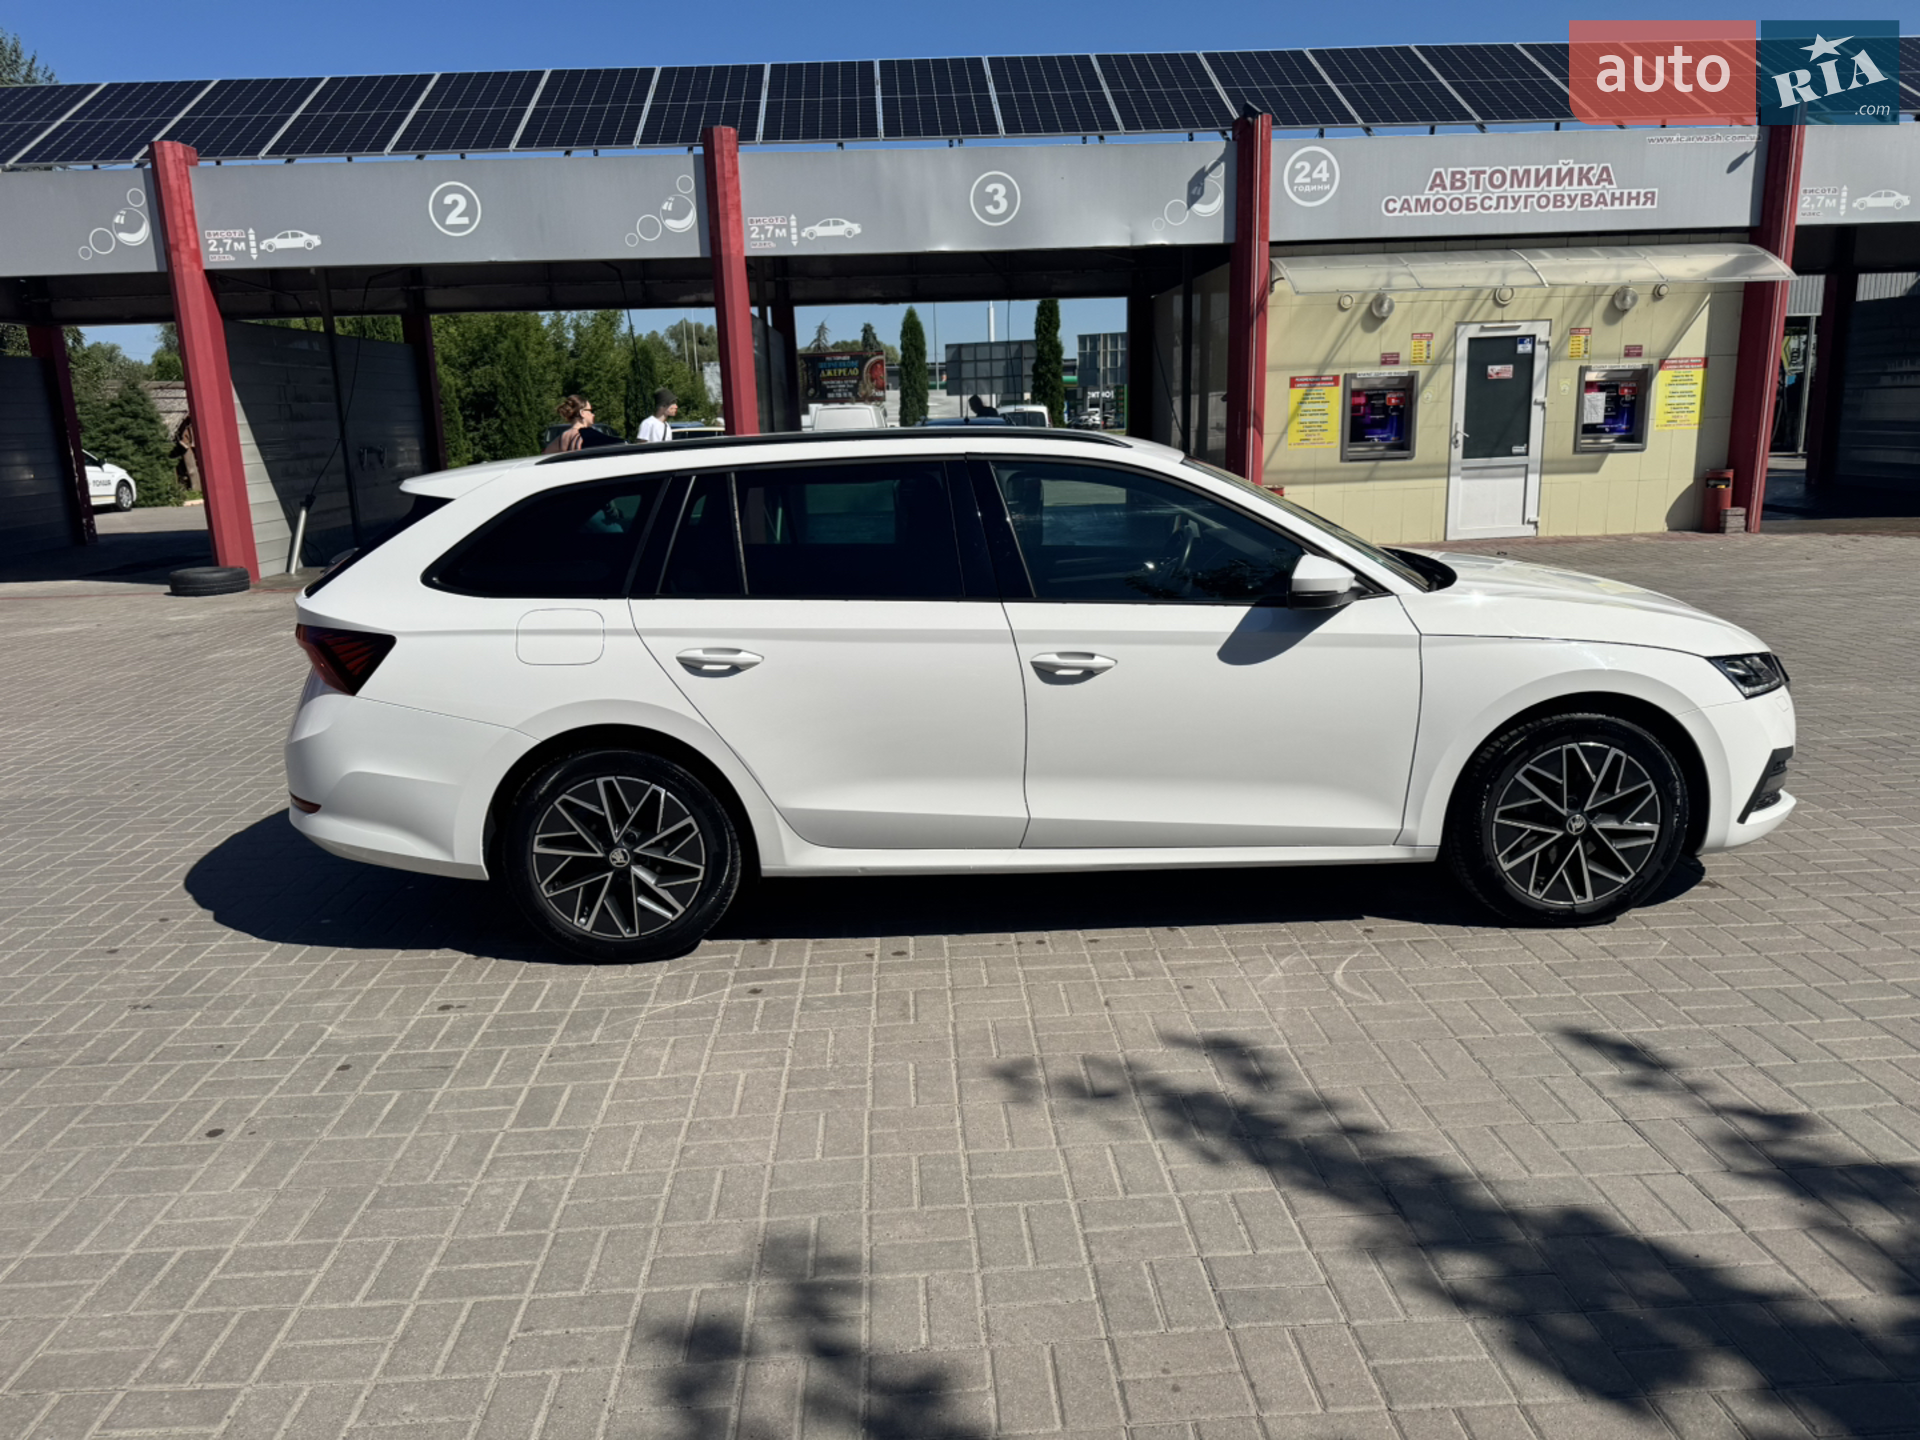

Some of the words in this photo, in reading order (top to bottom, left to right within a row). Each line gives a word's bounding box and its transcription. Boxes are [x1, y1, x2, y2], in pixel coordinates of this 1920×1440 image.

[1294, 160, 1330, 184] 24
[1426, 160, 1616, 192] АВТОМИЙКА
[443, 193, 470, 225] 2
[984, 182, 1008, 216] 3
[1382, 189, 1658, 215] САМООБСЛУГОВУВАННЯ
